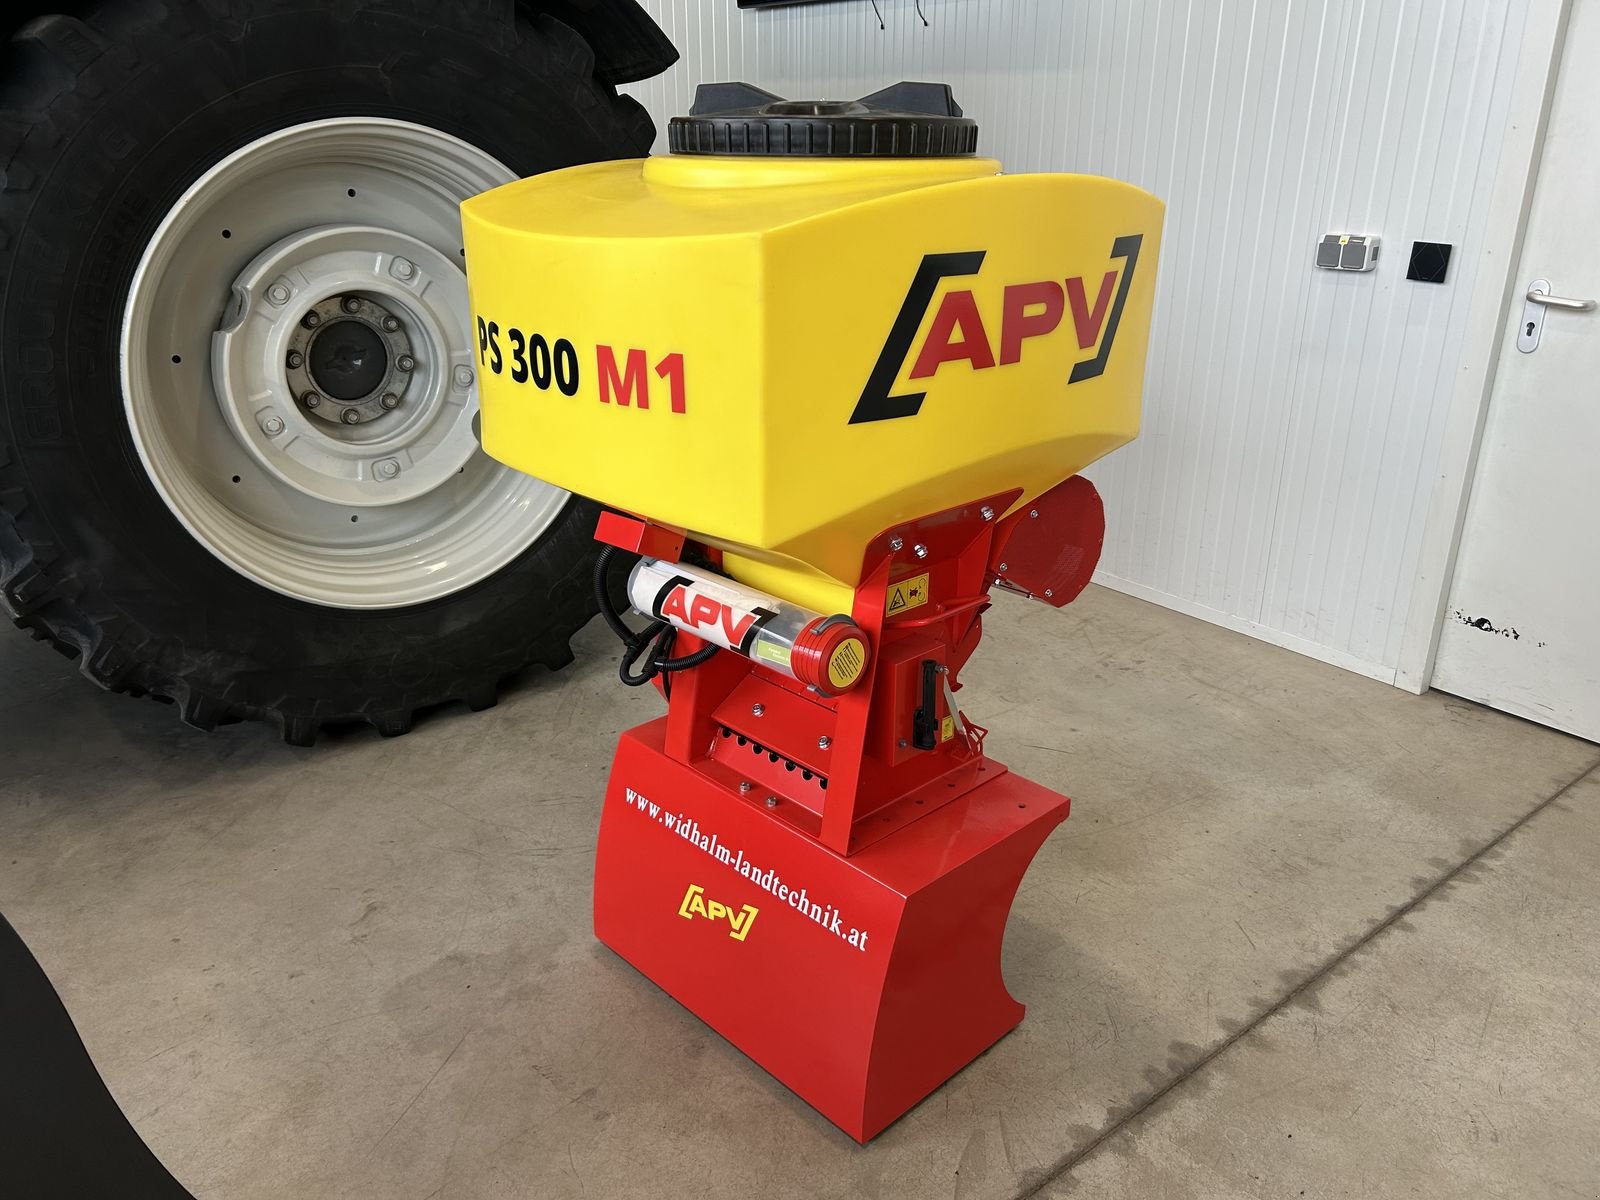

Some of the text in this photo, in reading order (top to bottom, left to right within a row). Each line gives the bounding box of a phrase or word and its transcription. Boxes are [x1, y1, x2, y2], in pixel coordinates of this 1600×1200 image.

[477, 315, 686, 414] PS 300 M1
[625, 787, 868, 952] www.widhalm-landtechnik.at
